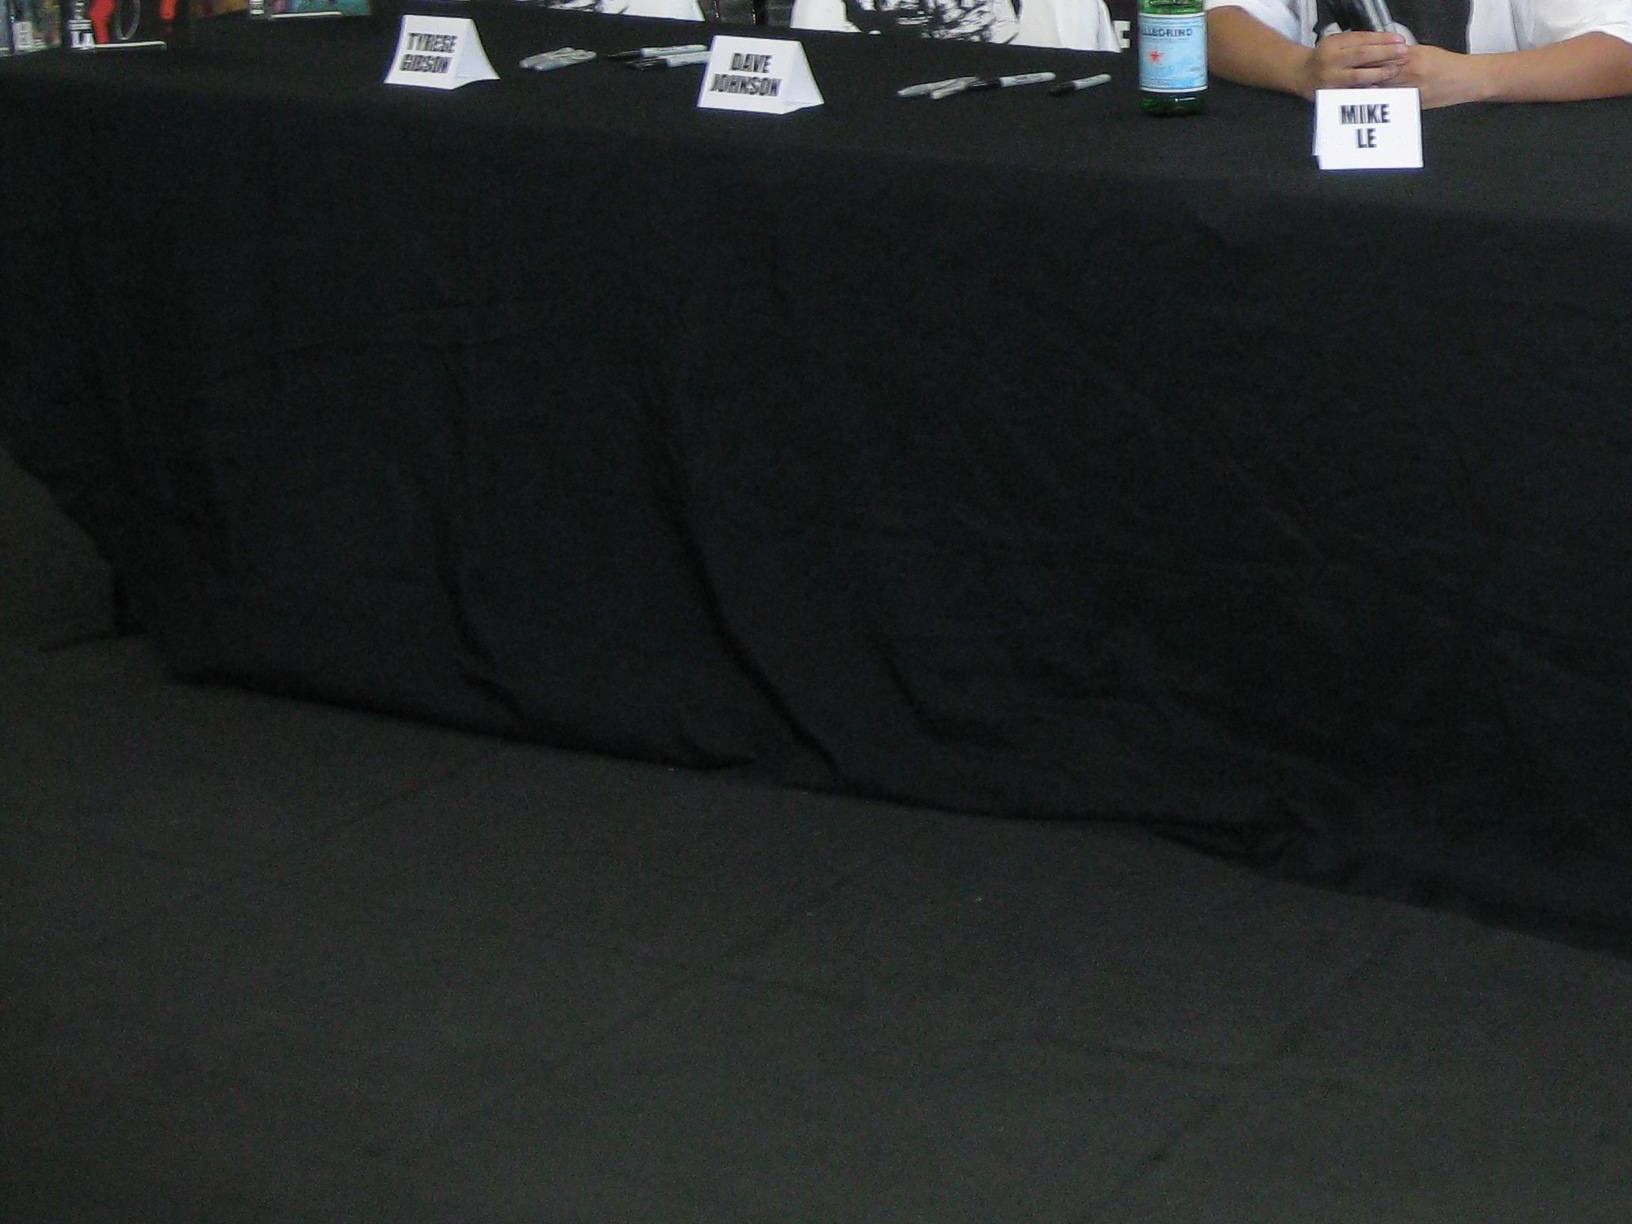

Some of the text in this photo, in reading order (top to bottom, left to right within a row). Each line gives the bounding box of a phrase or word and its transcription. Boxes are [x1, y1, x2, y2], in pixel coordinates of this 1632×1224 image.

[406, 33, 458, 54] TYRESE
[400, 53, 452, 75] GIBSON
[730, 52, 771, 73] DAVE
[710, 73, 783, 97] JOHNSON
[1339, 103, 1391, 126] MIKE
[1355, 127, 1377, 149] LE
